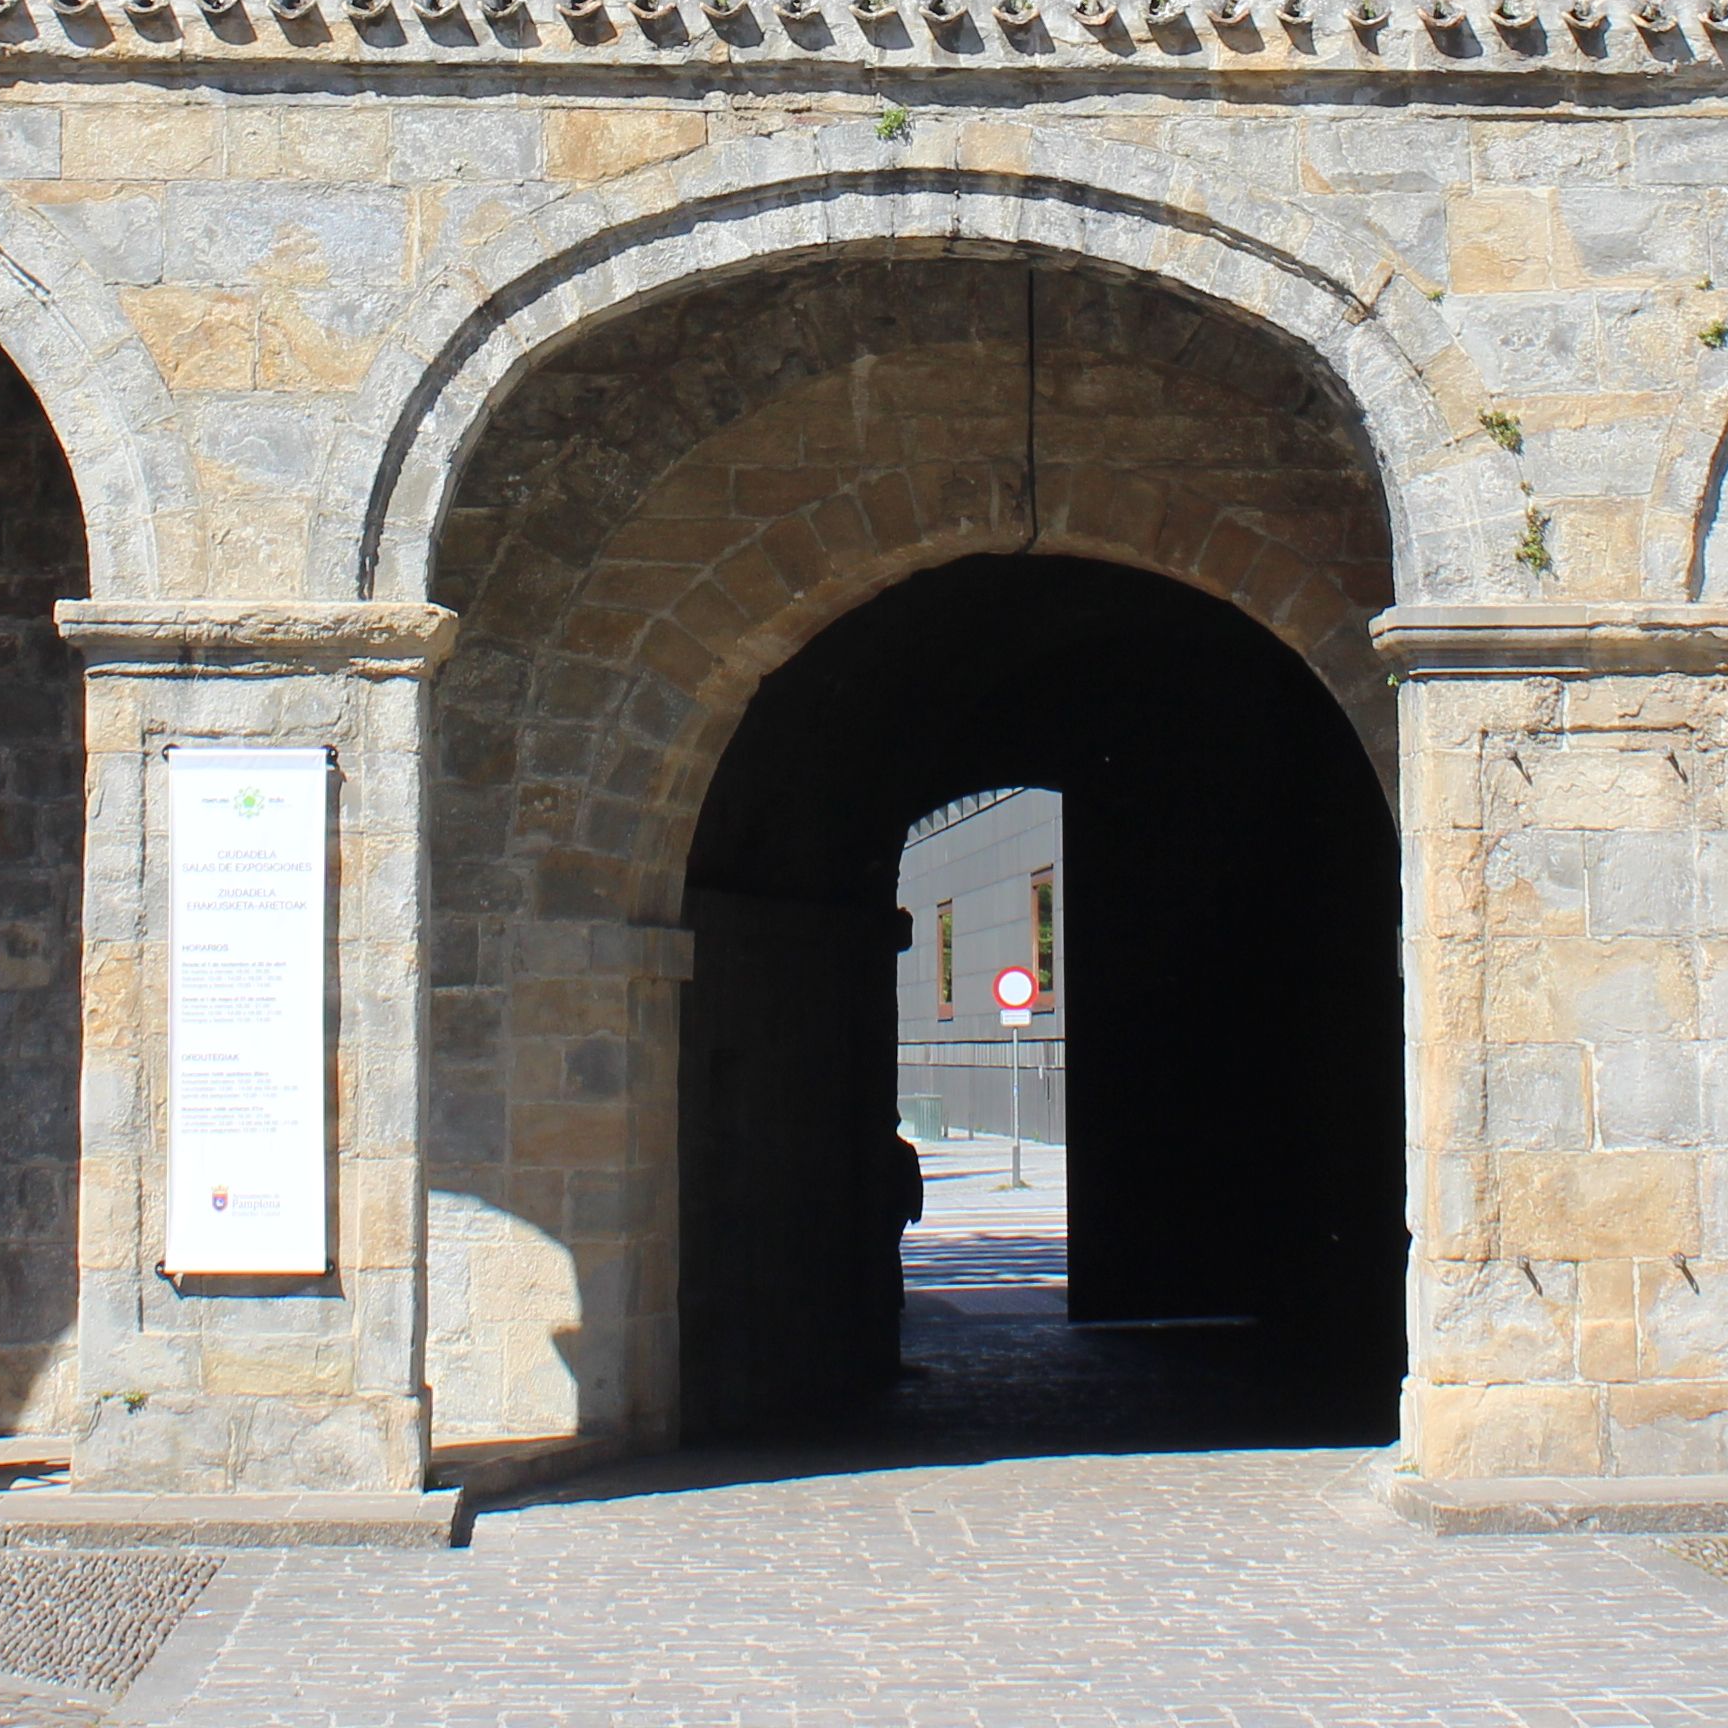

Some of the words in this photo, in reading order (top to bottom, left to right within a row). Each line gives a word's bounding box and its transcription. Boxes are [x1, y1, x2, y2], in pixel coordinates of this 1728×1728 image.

[217, 849, 278, 860] CIUDADELA
[182, 862, 216, 873] SALAS
[218, 862, 233, 873] DE
[235, 862, 313, 873] EXPOSICIONES
[217, 887, 278, 898] ZIUDADELA
[182, 944, 229, 952] HORARIOS
